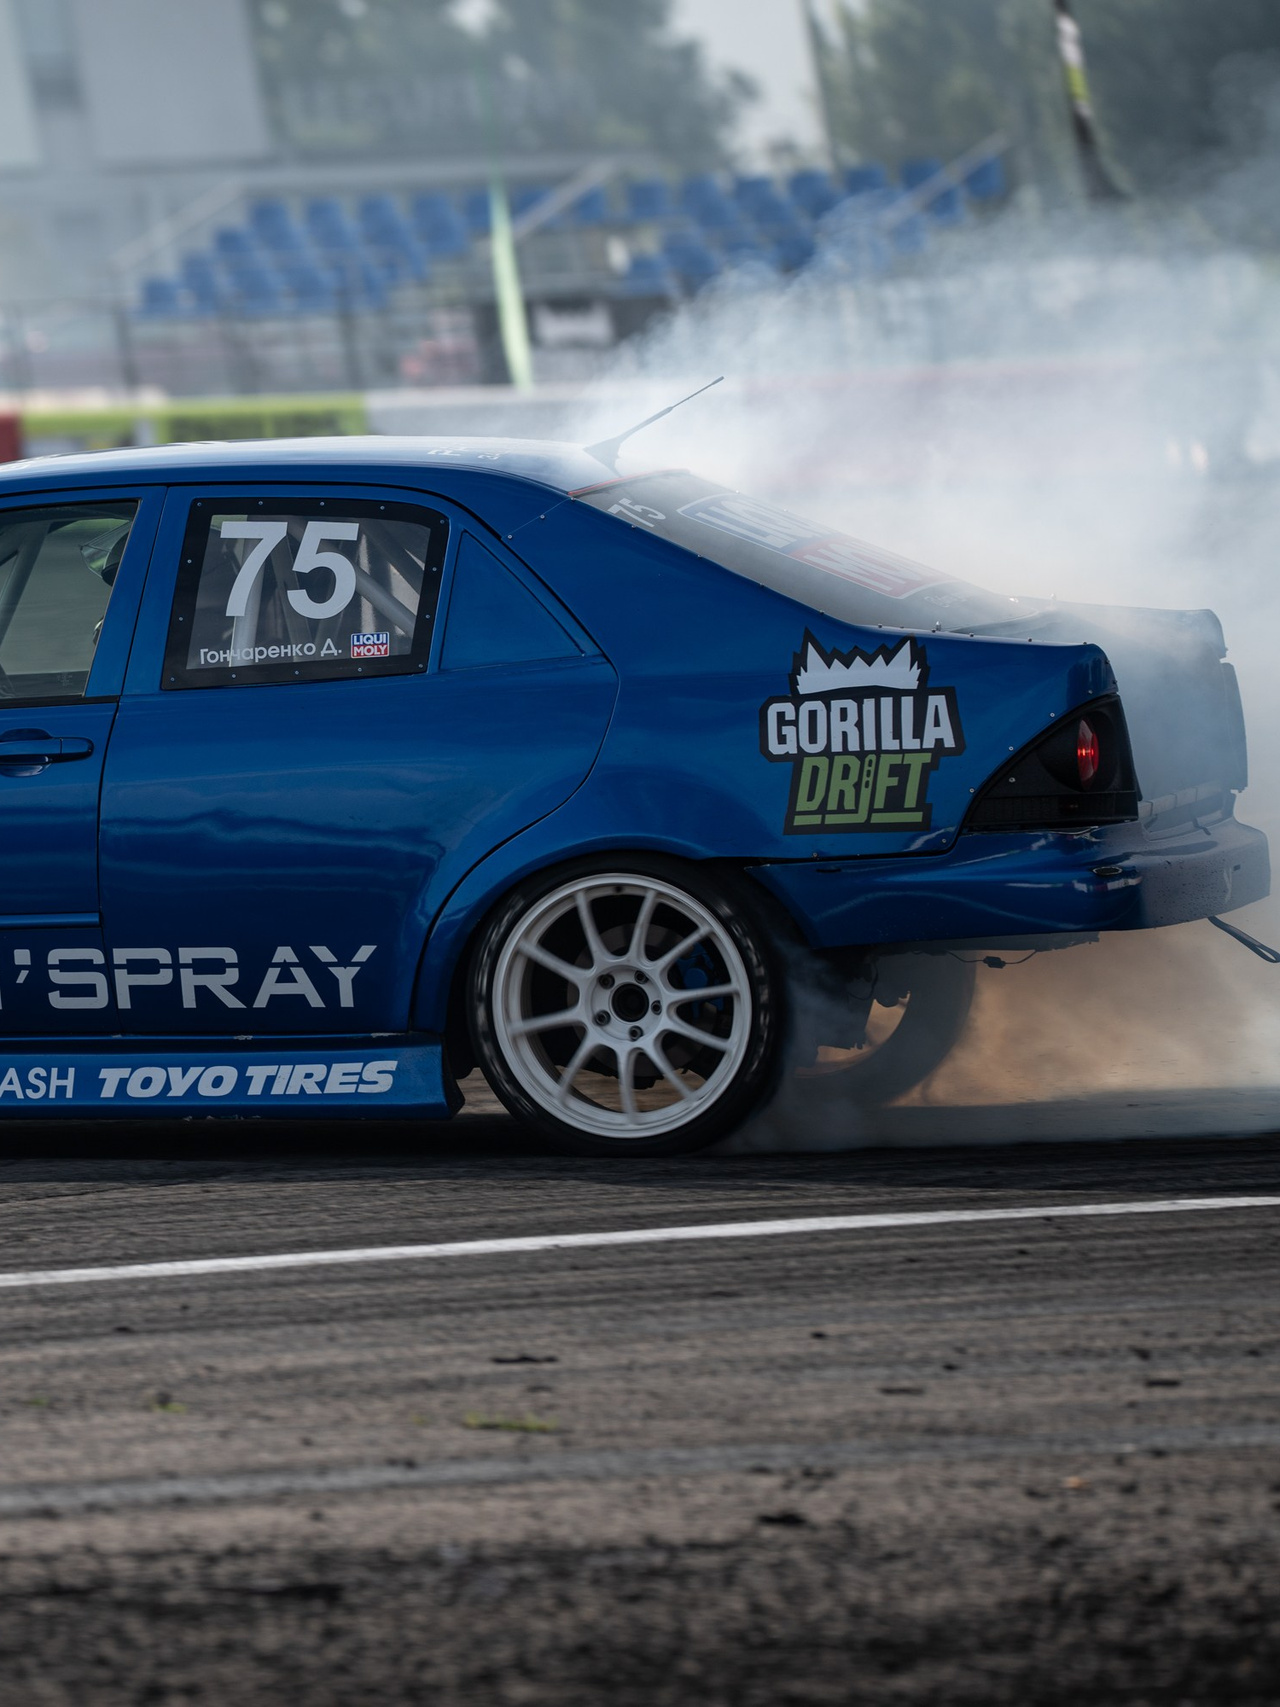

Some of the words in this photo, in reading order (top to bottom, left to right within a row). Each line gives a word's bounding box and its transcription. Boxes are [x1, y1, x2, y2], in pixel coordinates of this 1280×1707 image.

[607, 498, 666, 528] 75
[695, 498, 838, 549] LIQU
[220, 520, 360, 619] 75
[200, 642, 317, 665] Гончаренко
[320, 638, 342, 657] Д.
[353, 633, 387, 645] LIQUI
[353, 645, 388, 656] MOLY
[767, 694, 956, 755] GORILLA
[793, 752, 933, 825] DRIFT
[98, 1066, 238, 1098] TOYO
[245, 1060, 398, 1096] TIRES
